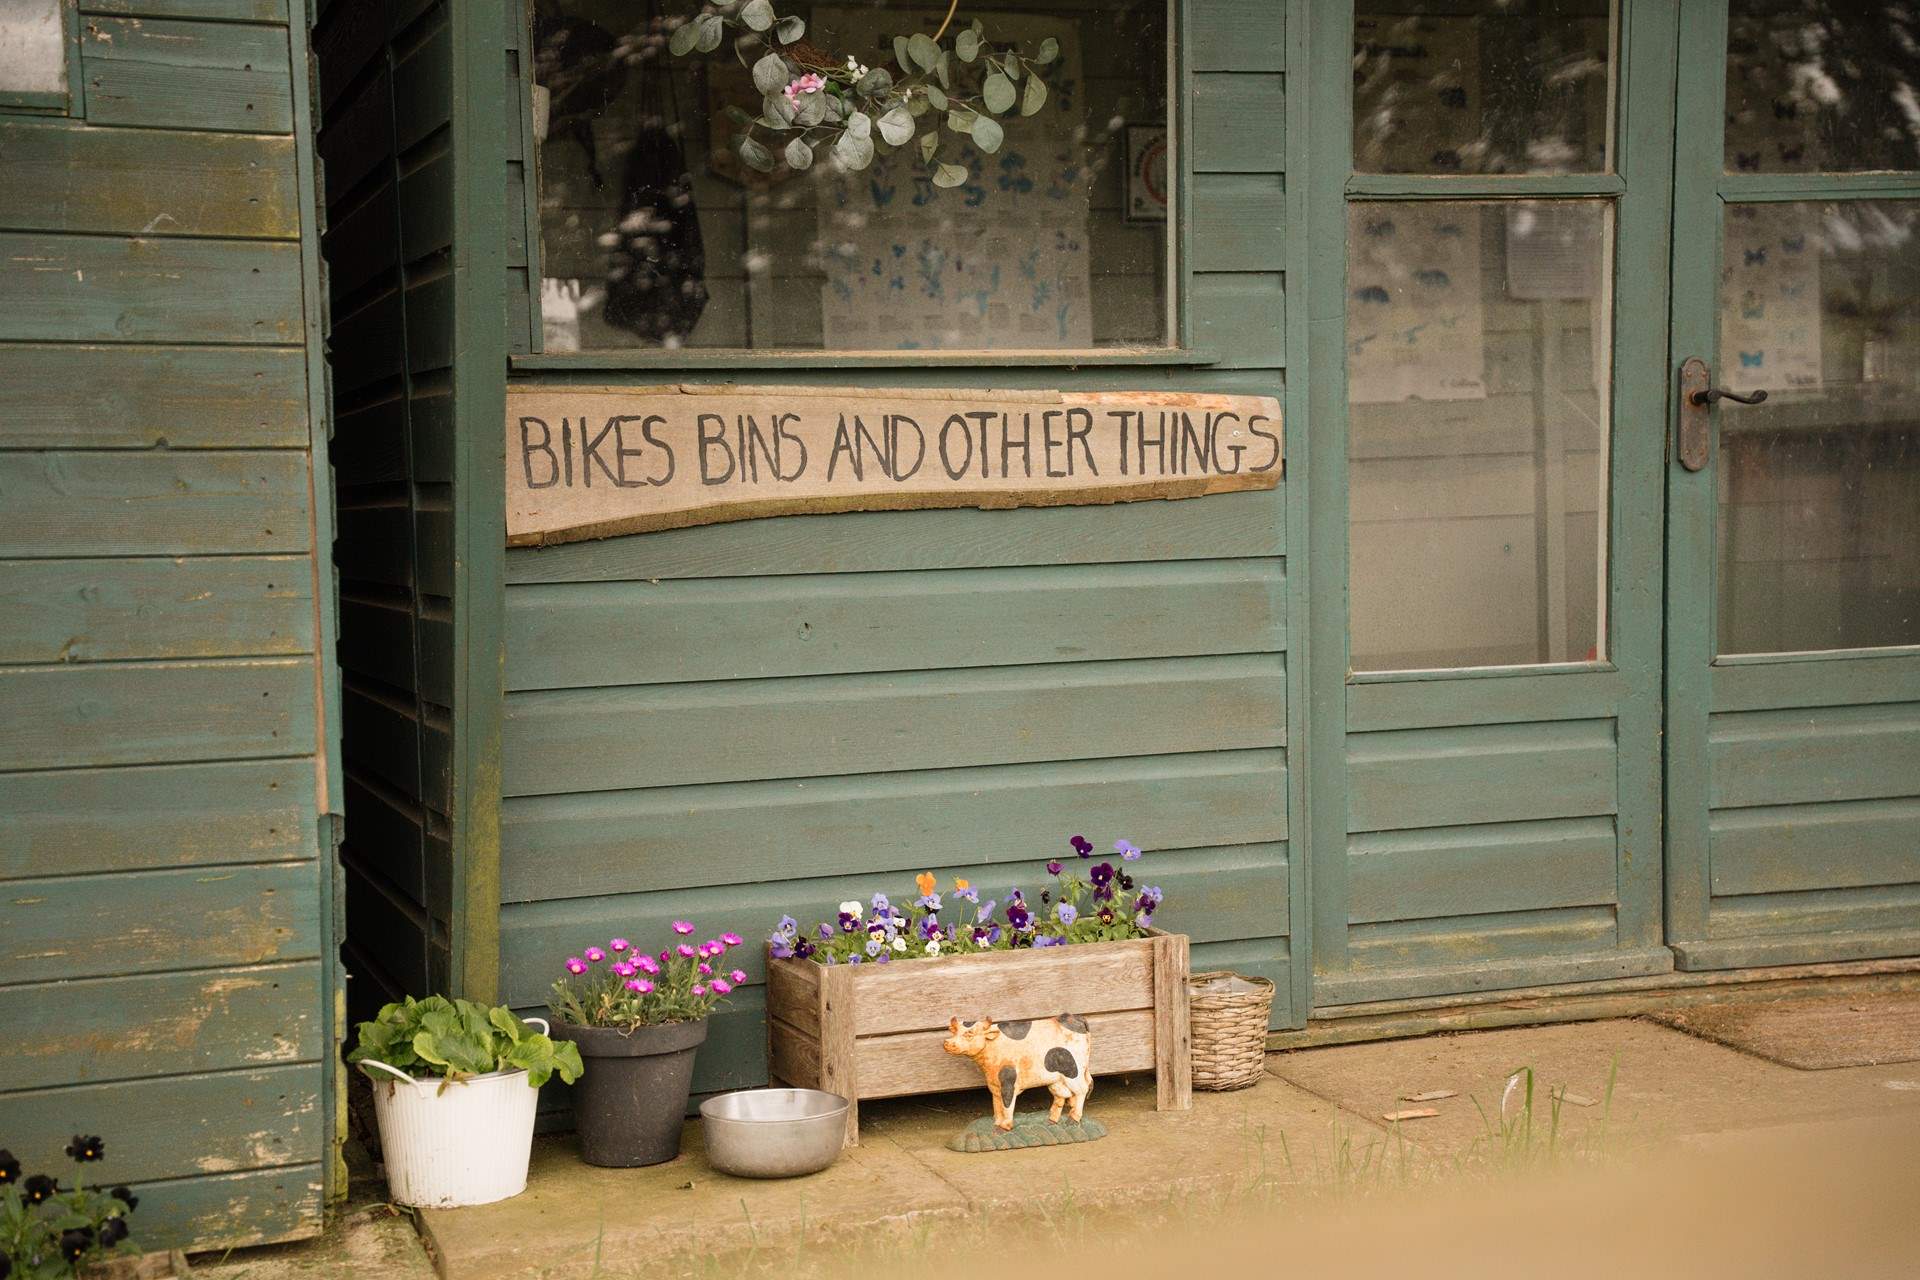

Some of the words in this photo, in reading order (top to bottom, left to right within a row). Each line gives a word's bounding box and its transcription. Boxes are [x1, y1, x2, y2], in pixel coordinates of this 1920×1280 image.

[519, 414, 676, 489] BIKES
[697, 412, 808, 486] BINS
[827, 412, 926, 482] AND
[938, 407, 1099, 481] OTHER
[1107, 411, 1281, 476] THINGS
